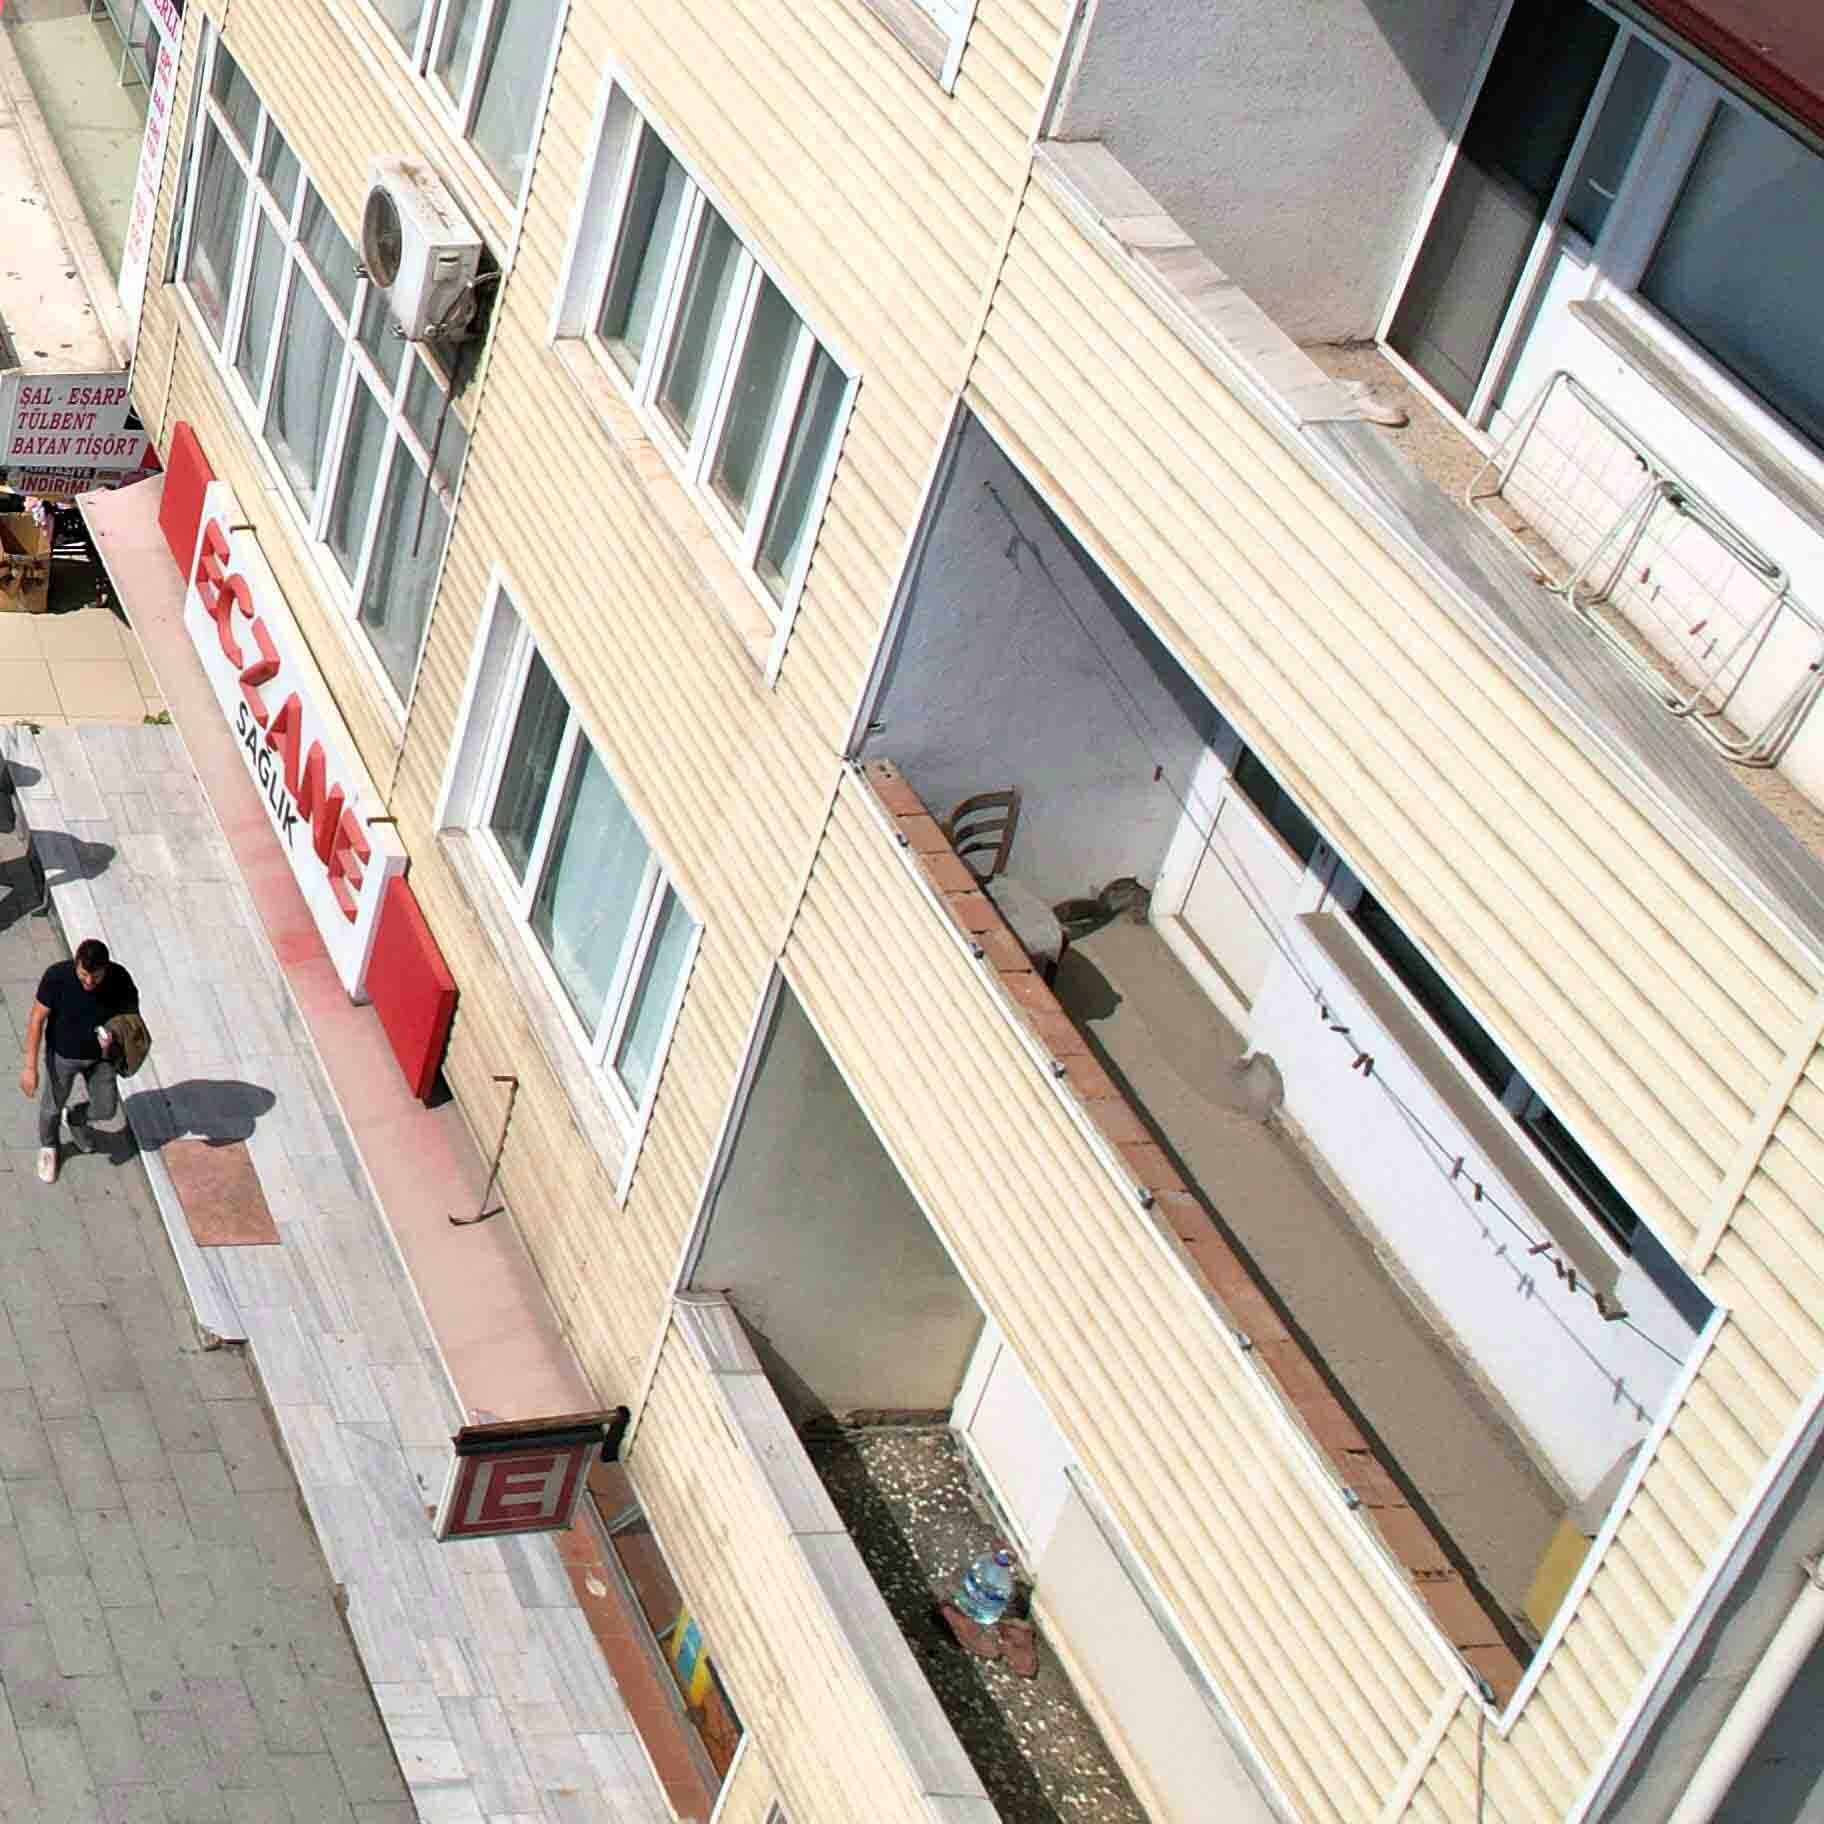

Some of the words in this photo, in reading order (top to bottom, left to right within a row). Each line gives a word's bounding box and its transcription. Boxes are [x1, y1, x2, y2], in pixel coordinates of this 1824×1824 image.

[19, 387, 52, 409] ŞAL
[67, 387, 128, 410] EŞARP
[17, 408, 97, 431] TÜLBENT
[12, 438, 70, 455] BAYAN
[75, 432, 139, 460] TİŞÖRT
[195, 516, 371, 925] ECZANE
[236, 702, 299, 848] SAĞLIK
